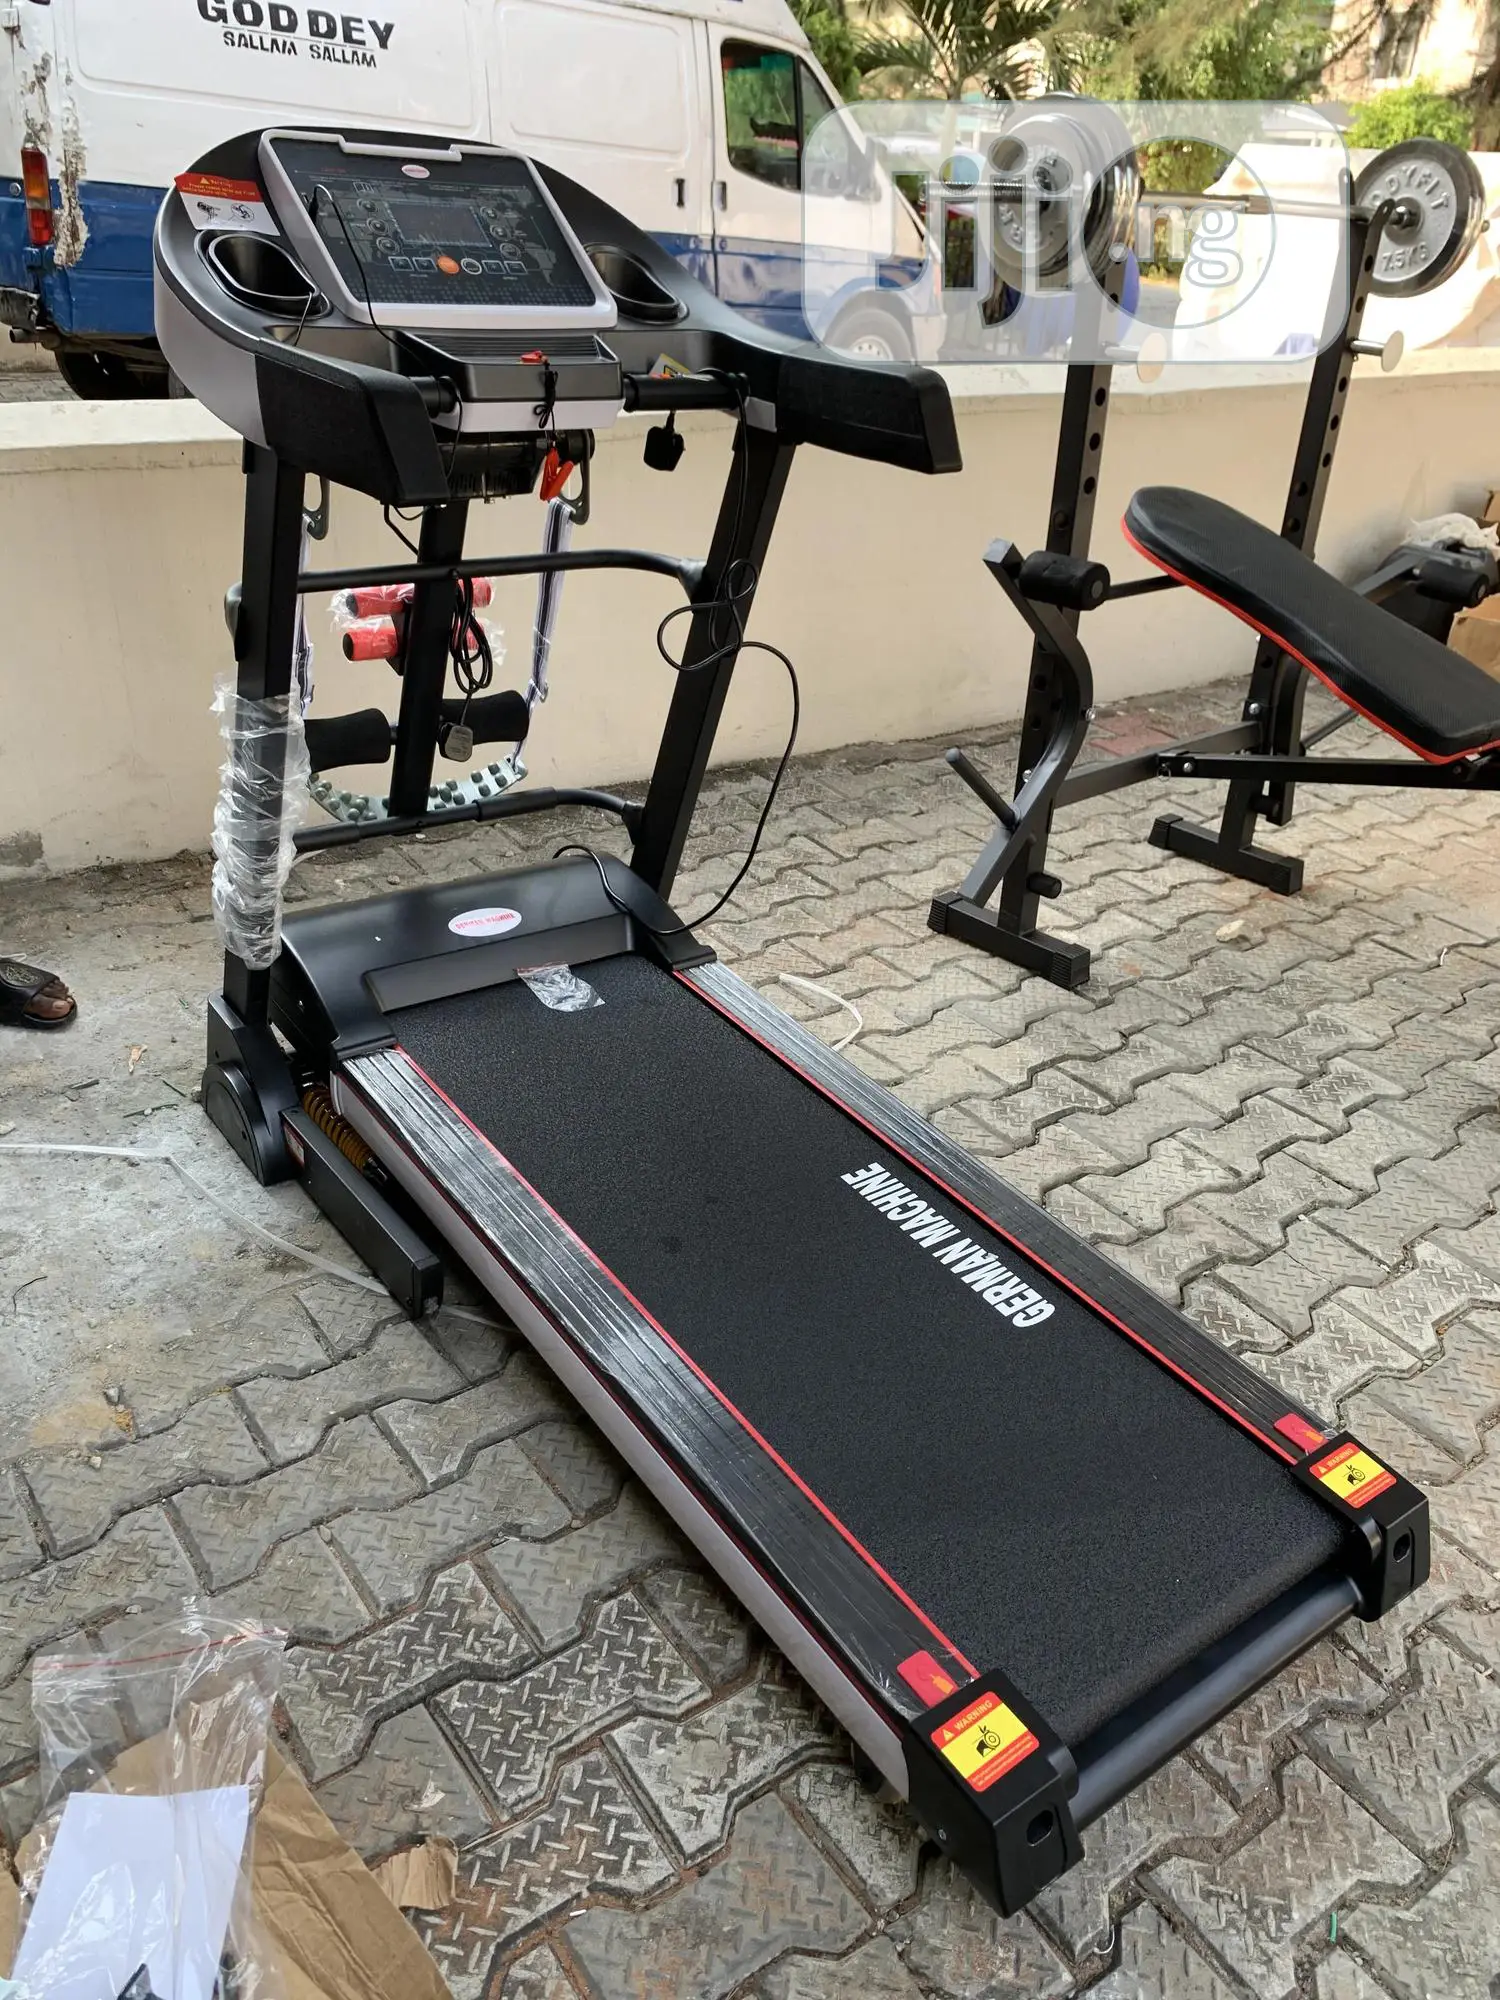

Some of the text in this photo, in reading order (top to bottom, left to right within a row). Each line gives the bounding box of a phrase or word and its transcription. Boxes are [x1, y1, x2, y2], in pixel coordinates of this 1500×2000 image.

[197, 0, 395, 49] GOD DEY
[223, 31, 377, 68] SALLAM SALLAM
[1368, 164, 1450, 210] ODYFIT
[840, 1162, 1056, 1328] GERMAN MACHINE
[953, 1699, 993, 1732] WARNING
